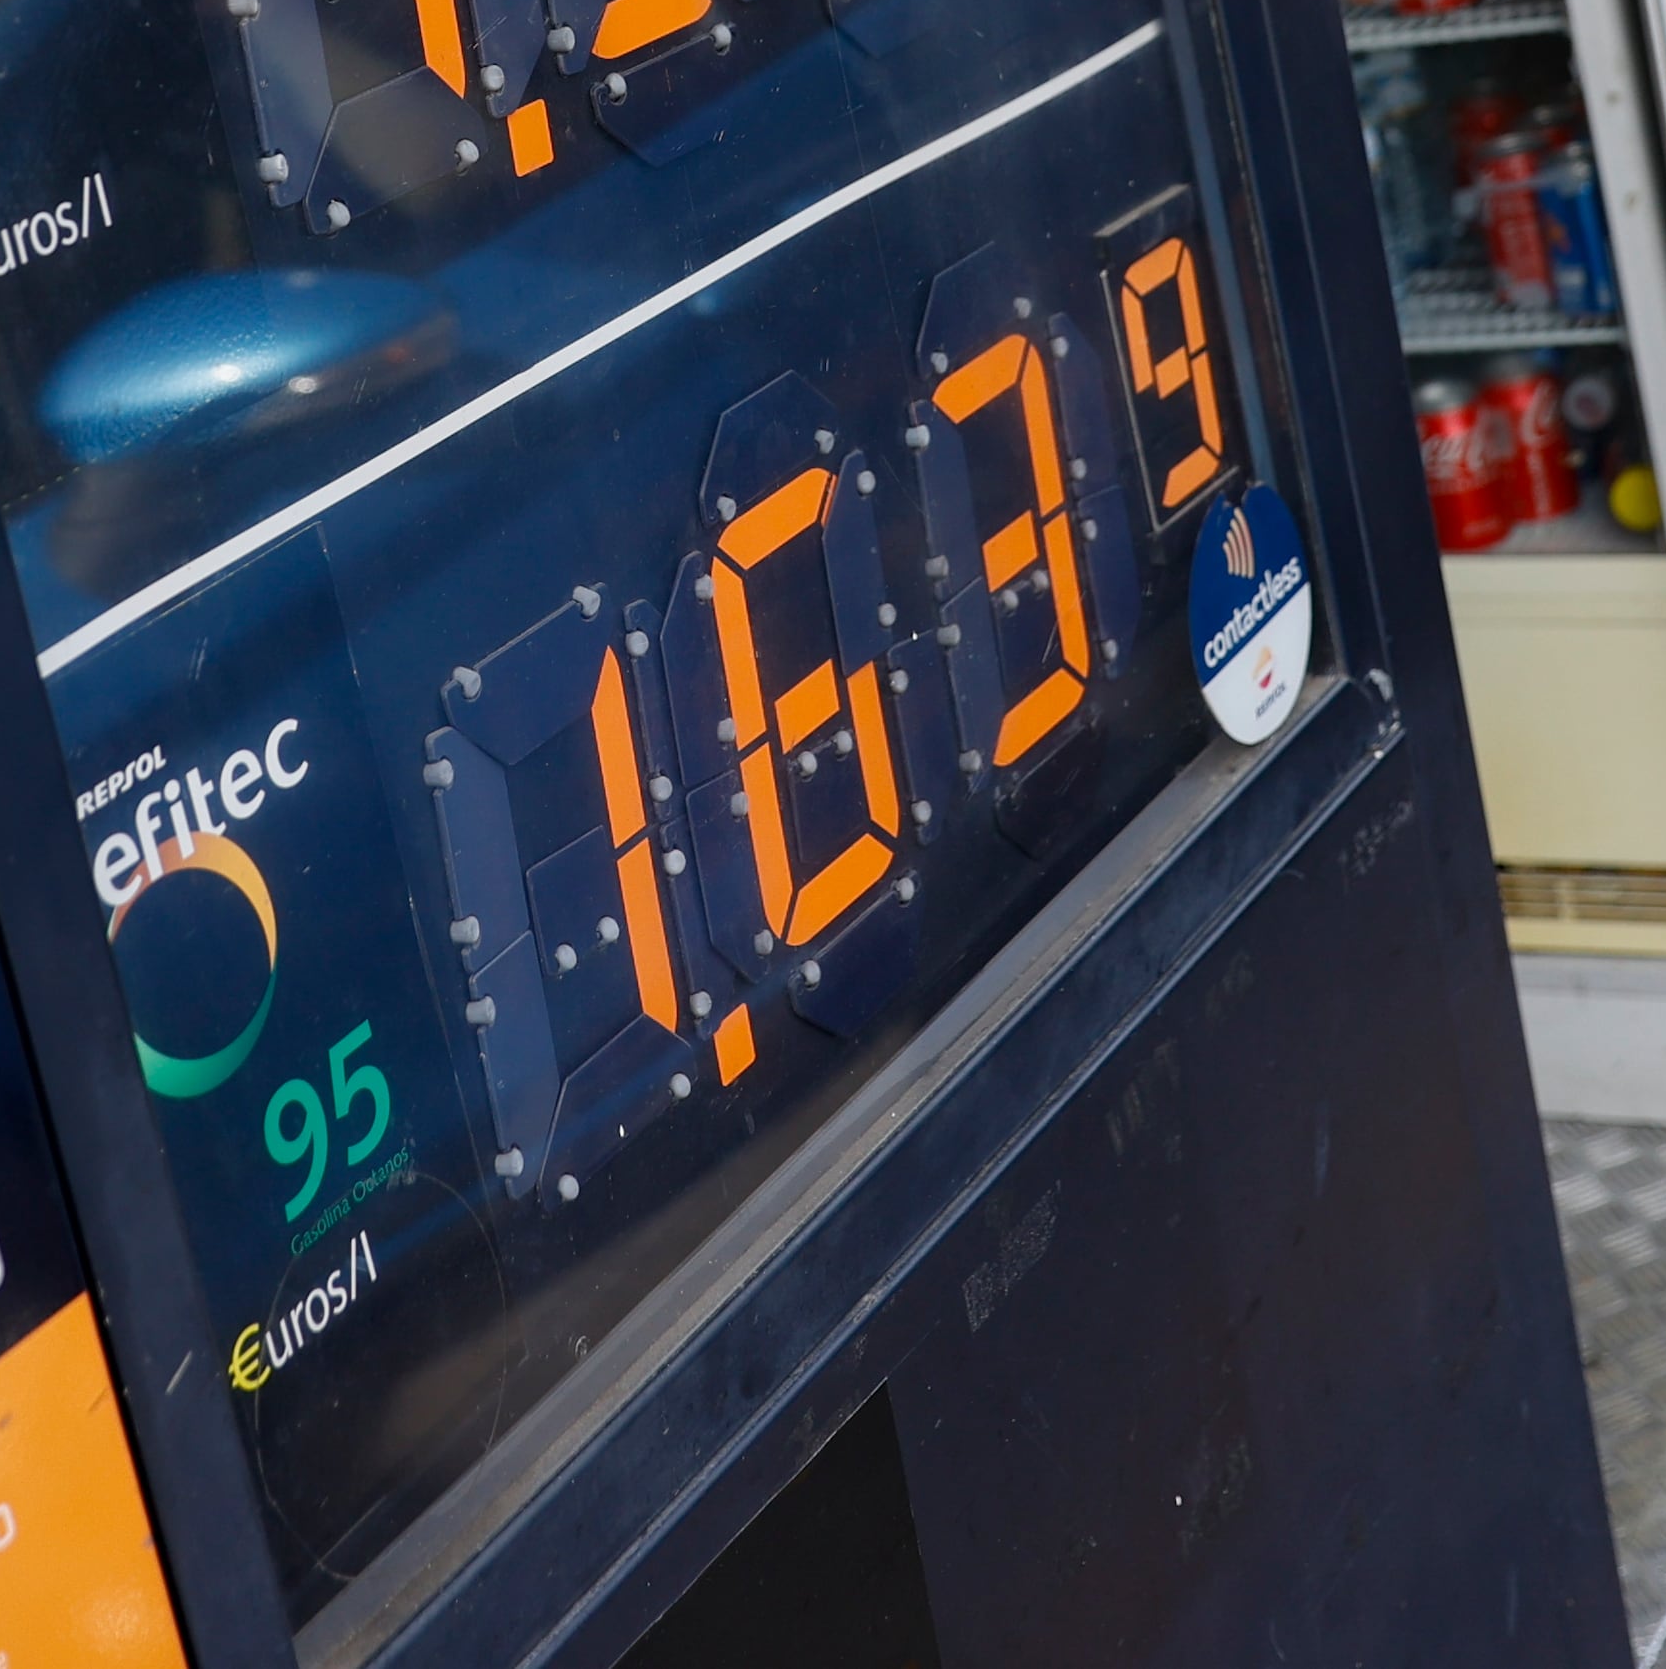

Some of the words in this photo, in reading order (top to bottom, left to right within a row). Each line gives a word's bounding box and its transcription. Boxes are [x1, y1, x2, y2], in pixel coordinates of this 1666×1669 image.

[1204, 556, 1303, 670] contactless
[76, 744, 167, 822] REPSOL
[91, 717, 309, 907] efitec
[263, 1018, 391, 1224] 95
[291, 1197, 351, 1255] Gasolina
[353, 1147, 409, 1202] Octanos
[228, 1229, 380, 1393] €uros/l
